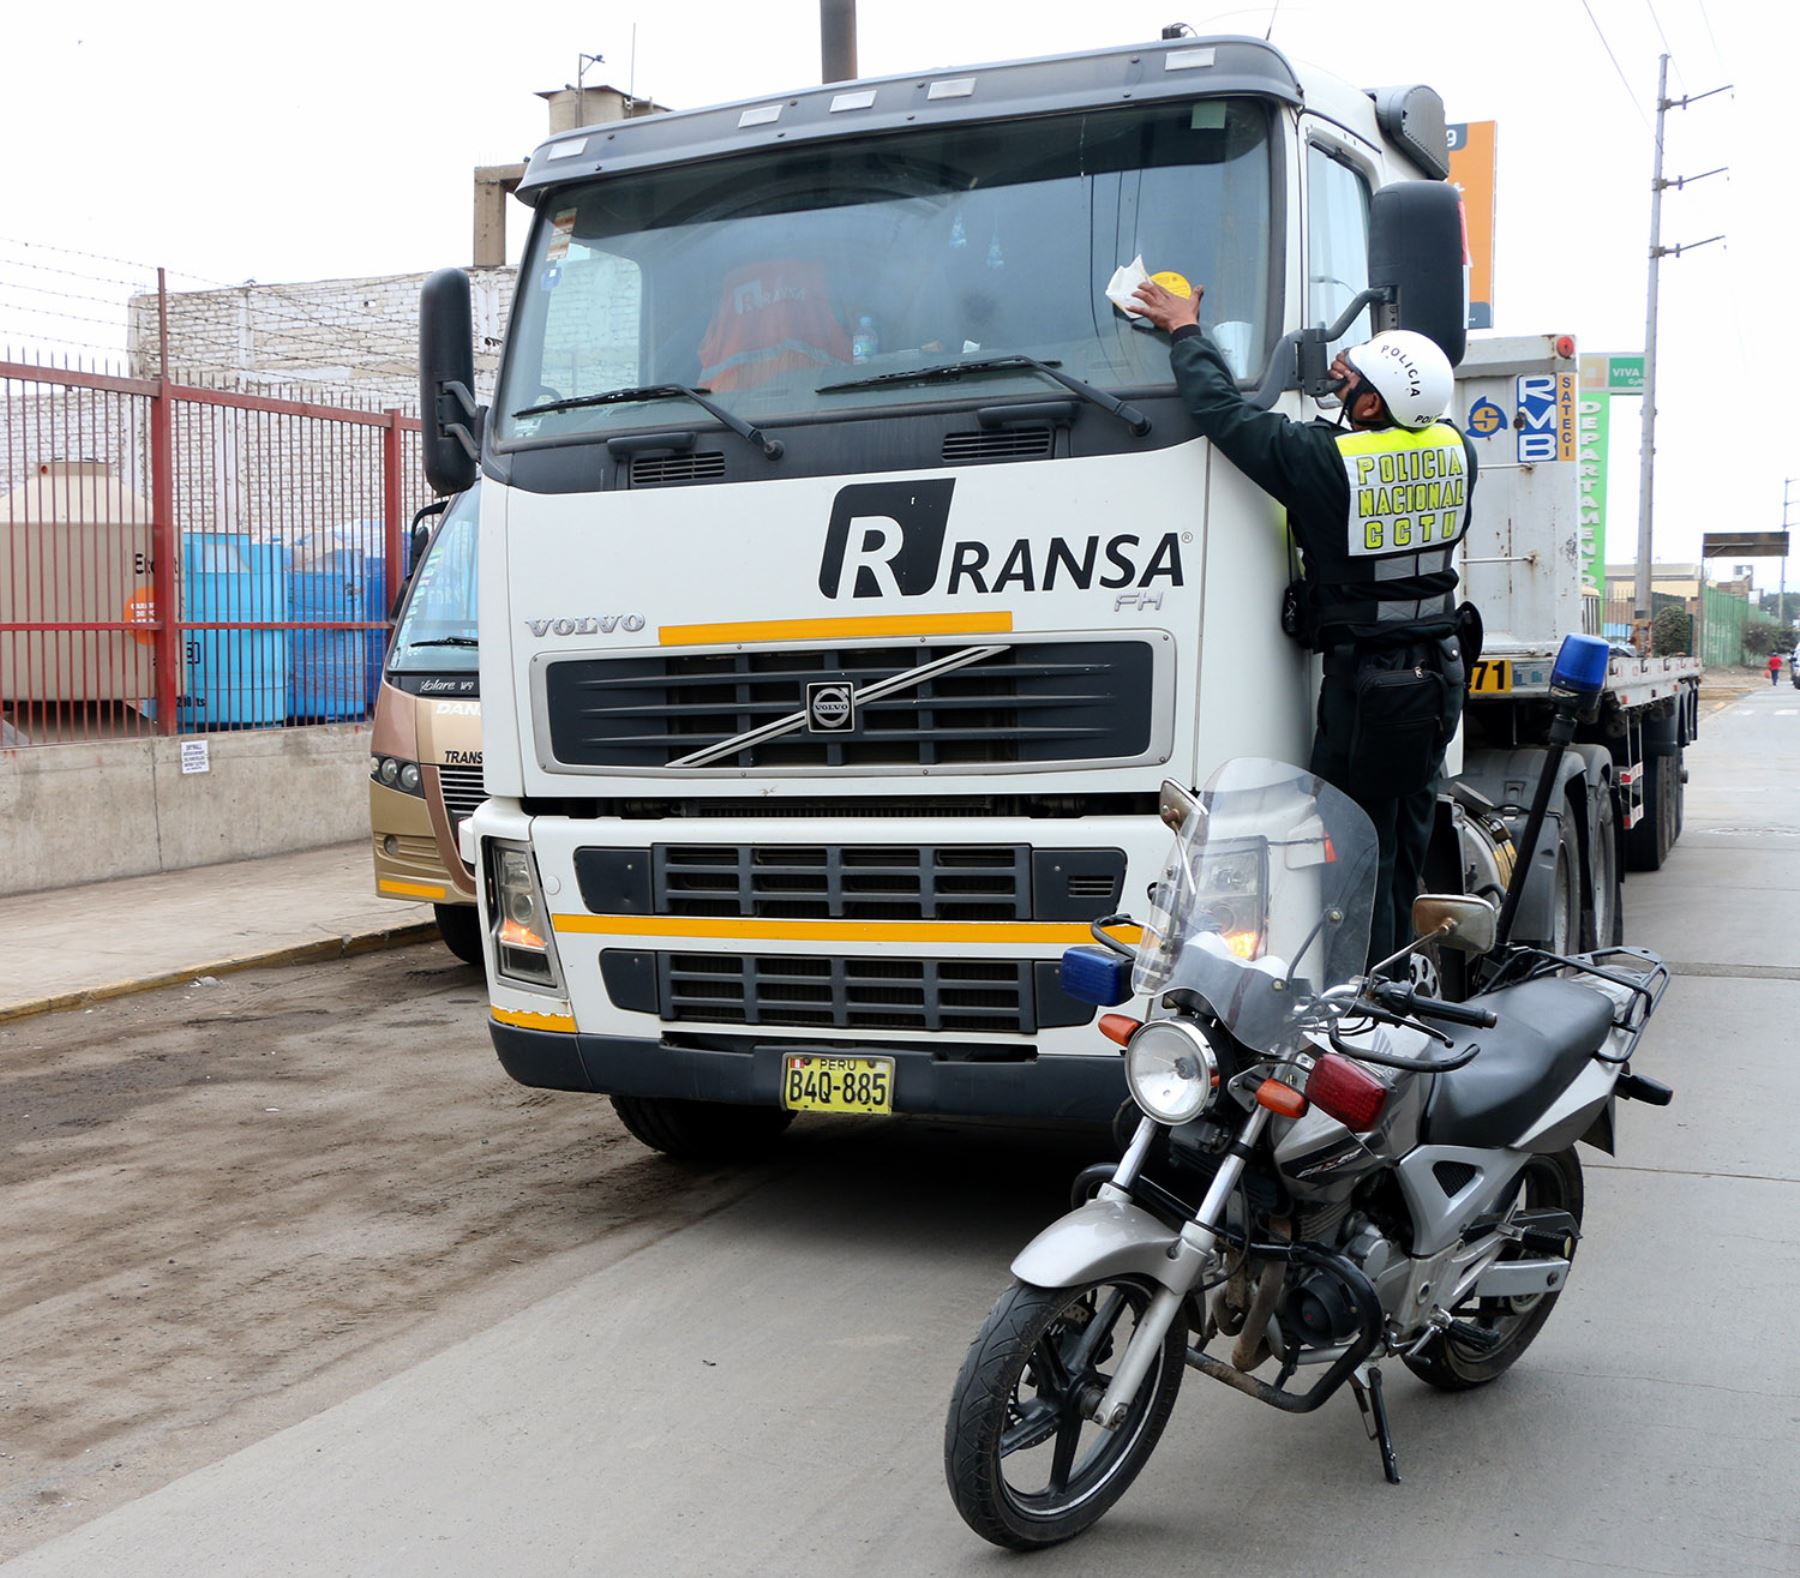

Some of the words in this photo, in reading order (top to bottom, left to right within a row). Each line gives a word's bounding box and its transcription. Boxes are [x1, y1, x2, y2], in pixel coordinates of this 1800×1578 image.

[1380, 344, 1421, 397] POLICIA
[1612, 368, 1640, 377] VIVA
[1561, 377, 1572, 457] SATECI
[1356, 447, 1463, 485] POLICIA
[1358, 479, 1464, 518] NACIONAL
[947, 532, 1184, 595] RANSA
[1114, 590, 1164, 612] FH
[525, 612, 646, 638] VOLVO
[820, 1059, 857, 1071] PERU
[790, 1070, 887, 1106] B4Q-885
